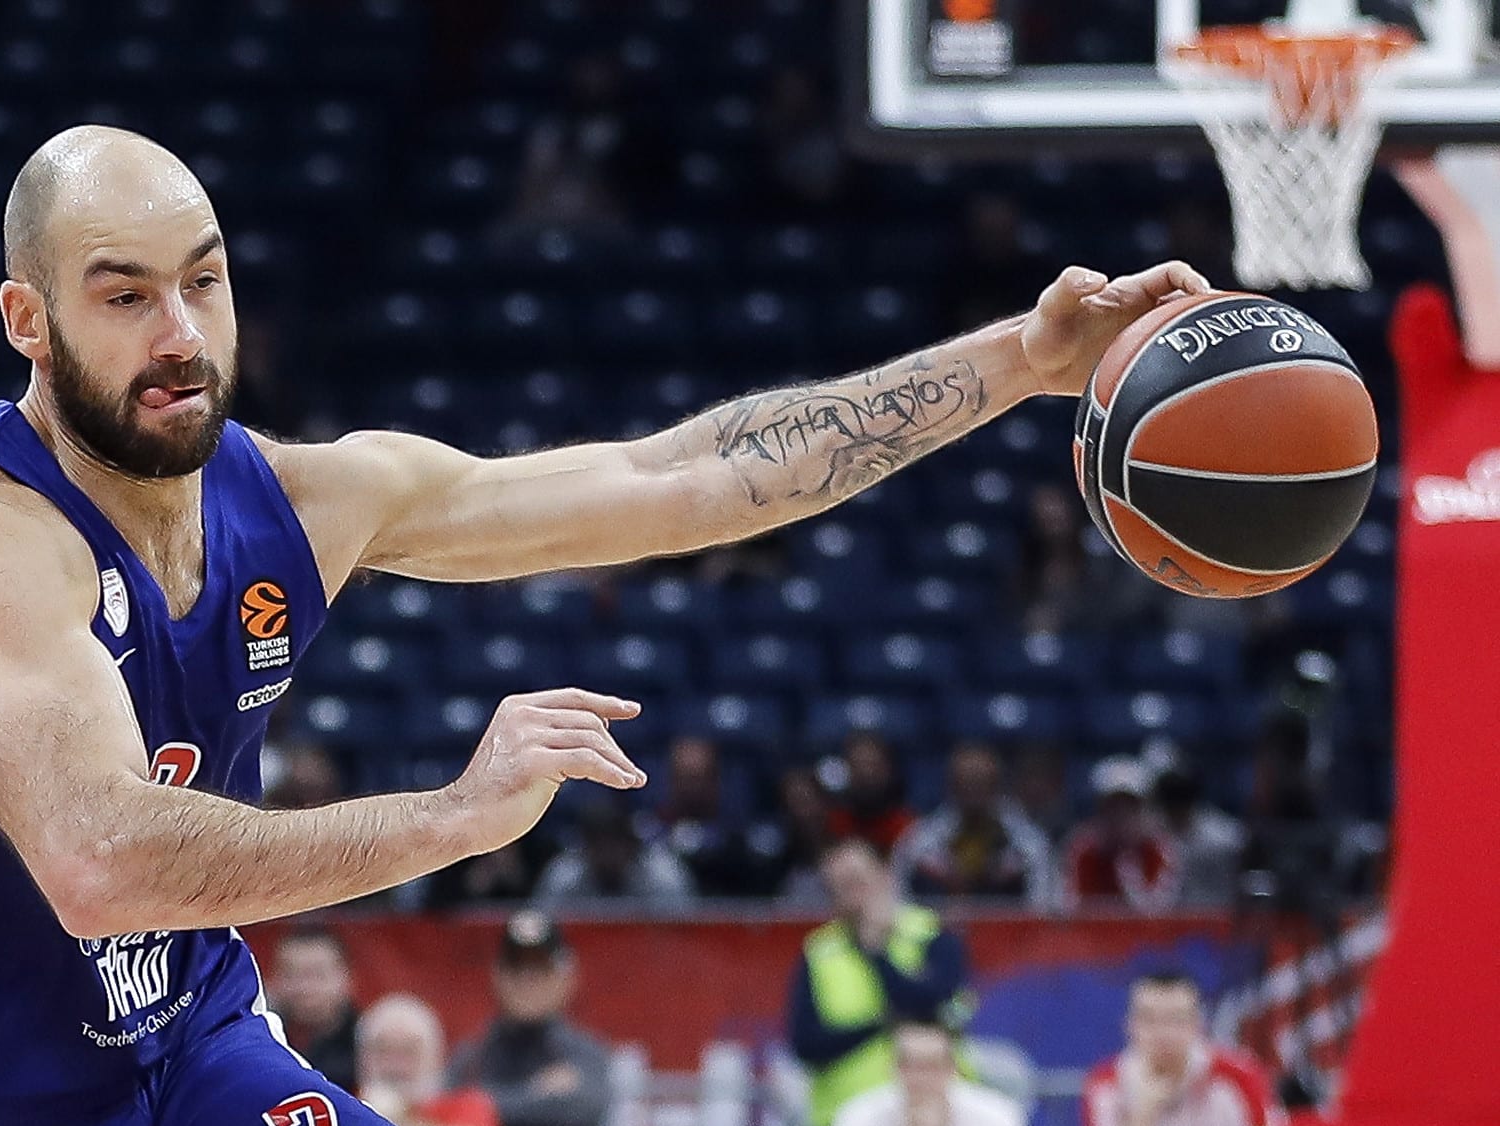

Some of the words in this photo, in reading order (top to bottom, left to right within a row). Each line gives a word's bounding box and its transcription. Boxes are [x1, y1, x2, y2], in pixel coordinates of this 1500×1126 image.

[246, 636, 289, 652] TURKISH
[249, 645, 289, 661] AIRLINES
[81, 1022, 138, 1047] Together
[146, 991, 194, 1033] Children
